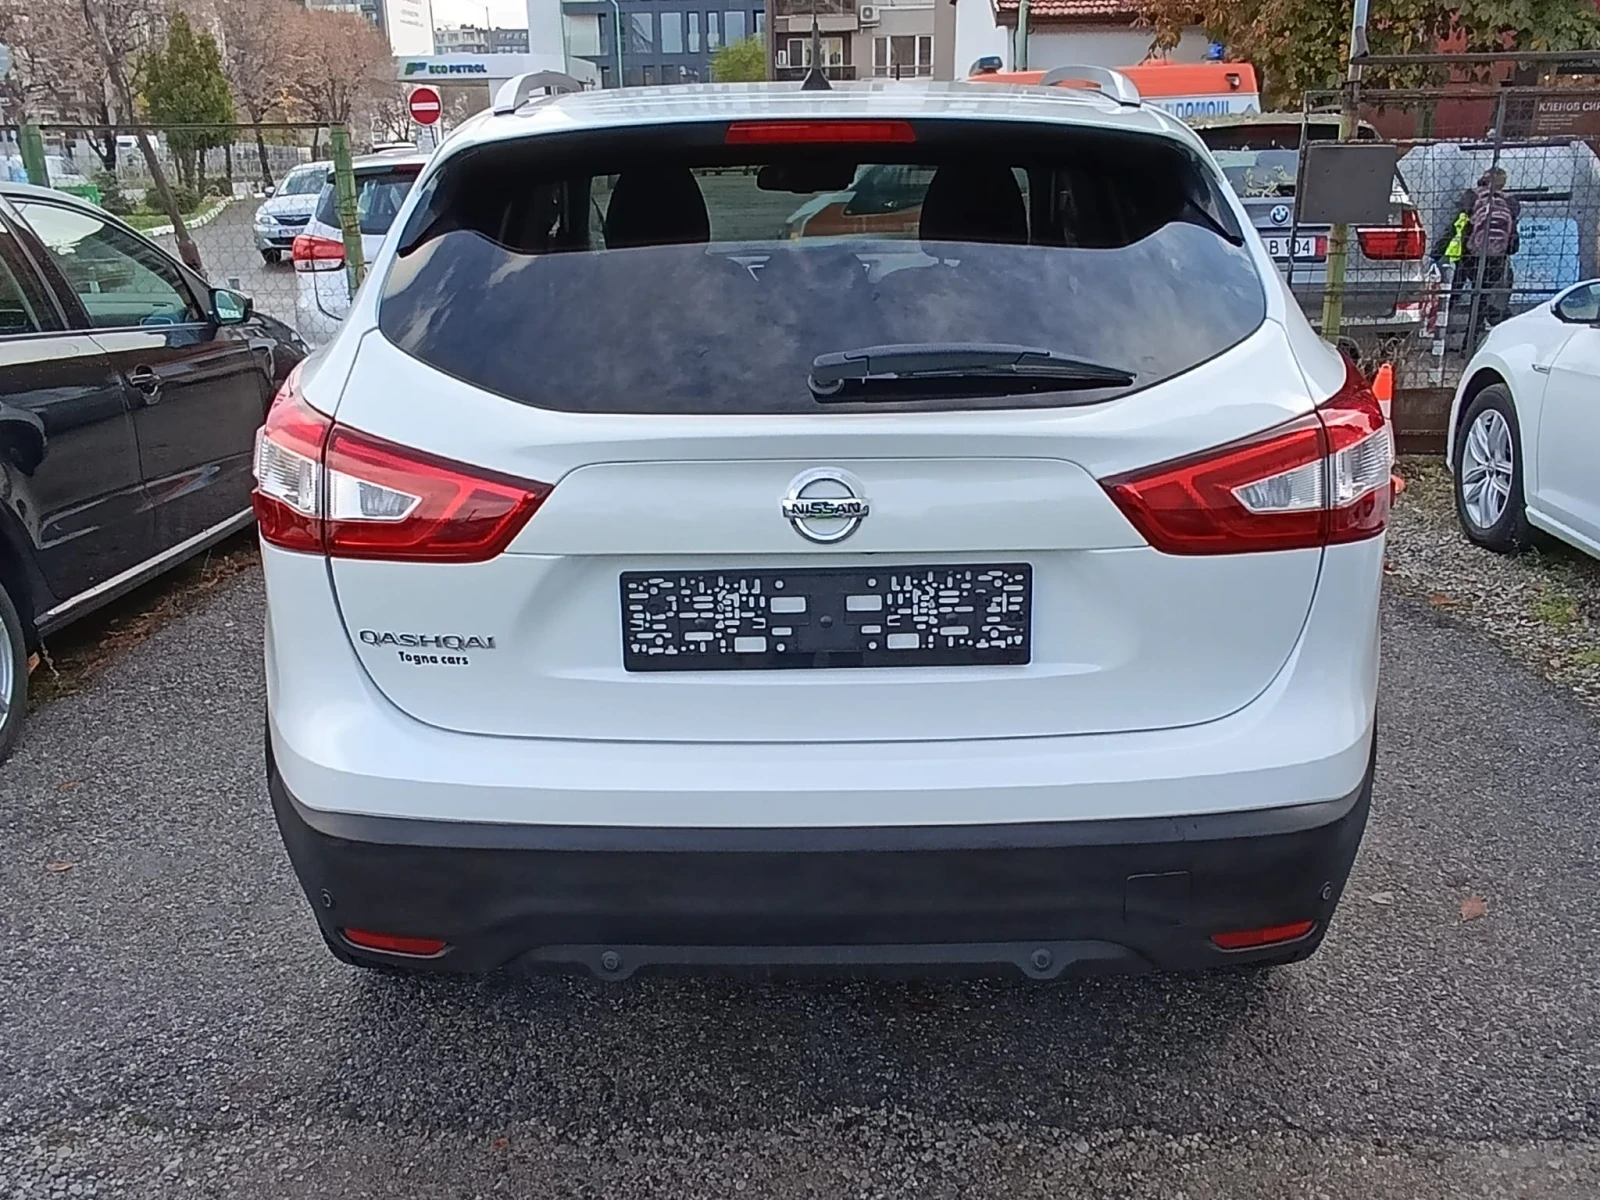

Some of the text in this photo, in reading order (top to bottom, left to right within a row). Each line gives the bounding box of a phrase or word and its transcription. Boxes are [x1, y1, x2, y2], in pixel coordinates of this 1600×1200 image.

[1538, 102, 1580, 112] КЛЕНОВ
[791, 501, 861, 515] NISSAN
[359, 629, 496, 652] QASHQAI
[398, 651, 469, 665] Togna cars
